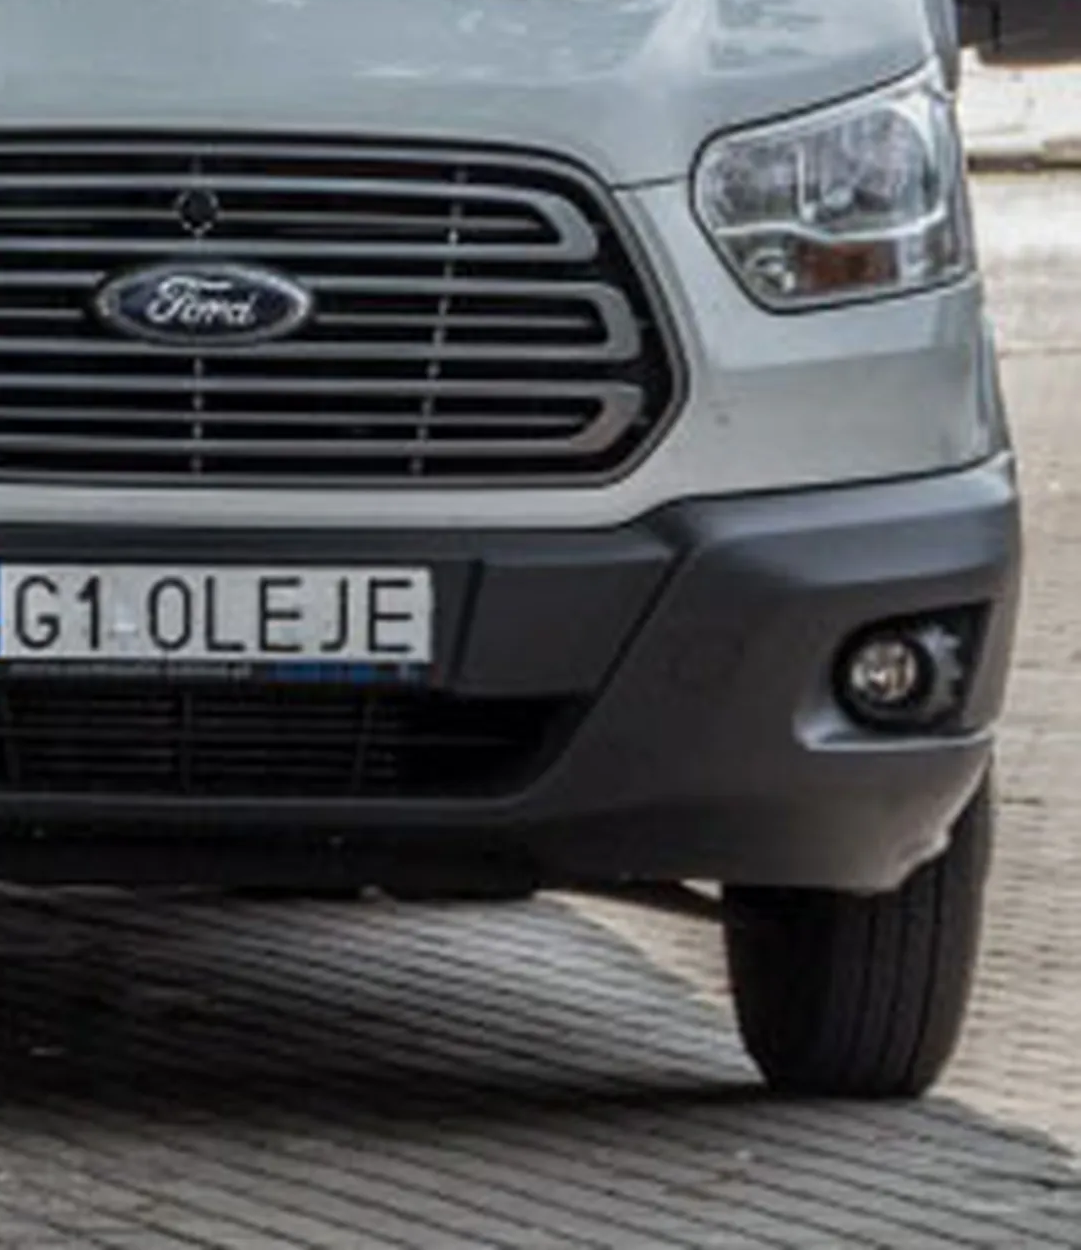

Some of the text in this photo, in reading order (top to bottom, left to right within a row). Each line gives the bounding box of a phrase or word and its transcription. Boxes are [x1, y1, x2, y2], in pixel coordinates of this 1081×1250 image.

[146, 275, 260, 325] Ford
[14, 575, 414, 653] G1 OLEJE
